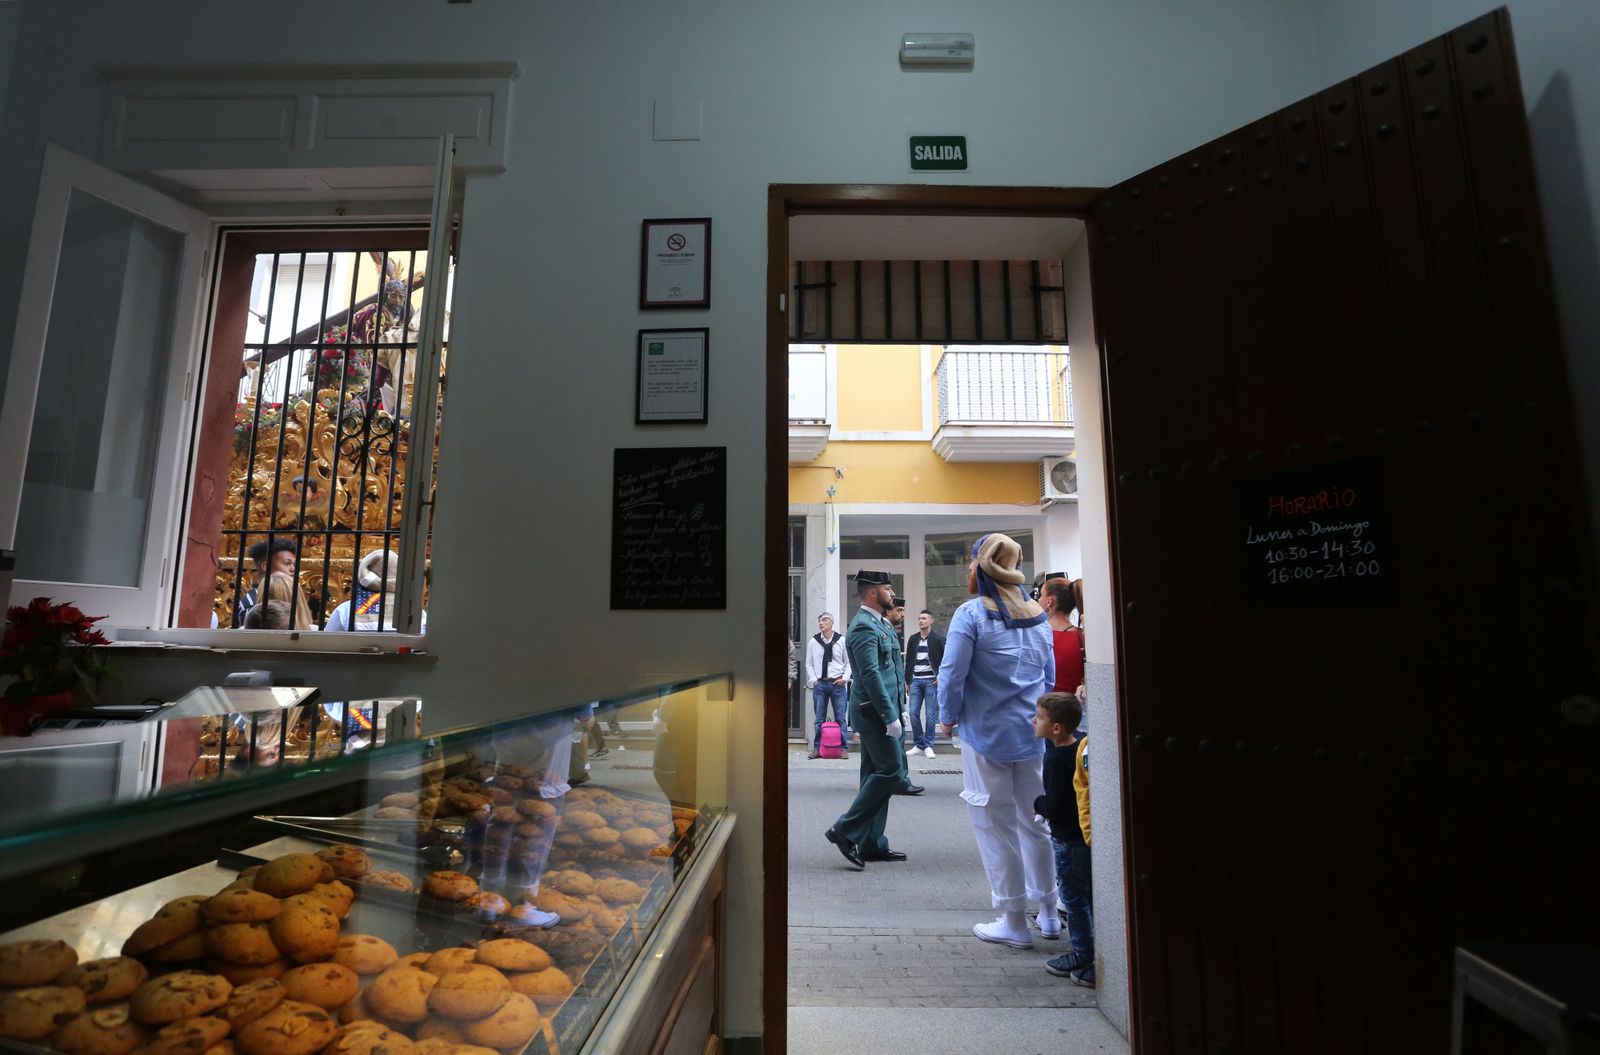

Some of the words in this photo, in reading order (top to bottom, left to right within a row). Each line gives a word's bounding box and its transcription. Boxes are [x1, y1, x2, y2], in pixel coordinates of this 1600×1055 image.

[915, 145, 963, 160] SALIDA
[1246, 525, 1294, 545] Lunes
[1297, 528, 1309, 536] a
[1309, 520, 1370, 538] Domingo
[1265, 540, 1376, 564] 10:30-14:30
[1266, 559, 1380, 584] 16:00-21:00
